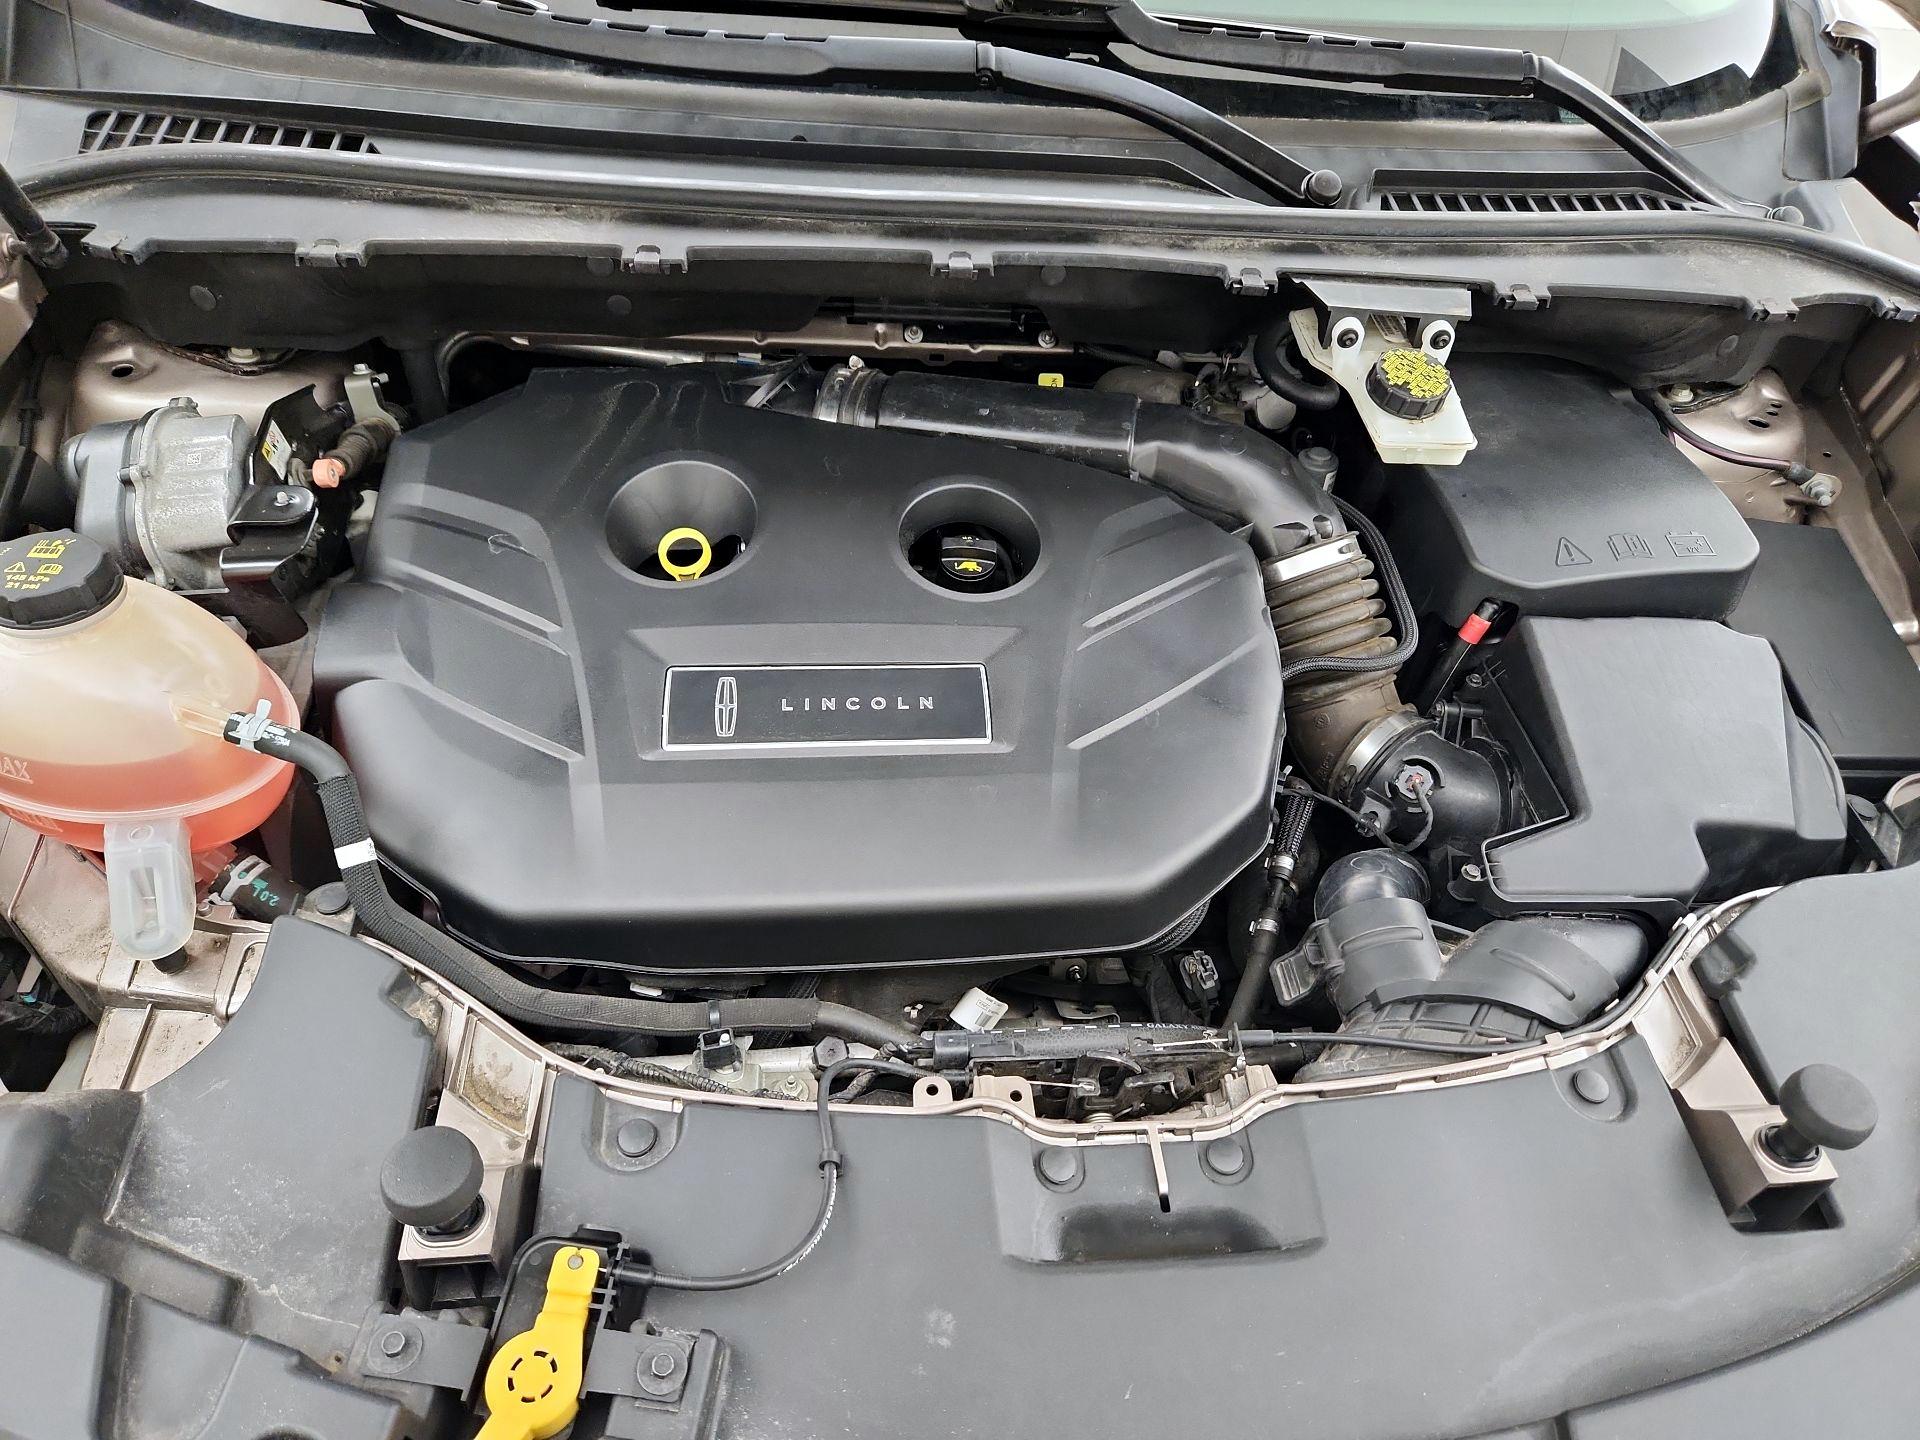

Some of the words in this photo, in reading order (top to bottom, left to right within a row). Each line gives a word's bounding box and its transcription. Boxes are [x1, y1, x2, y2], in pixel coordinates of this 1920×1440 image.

[28, 574, 50, 582] kPa
[781, 696, 935, 711] LINCOLN
[0, 756, 30, 779] AX
